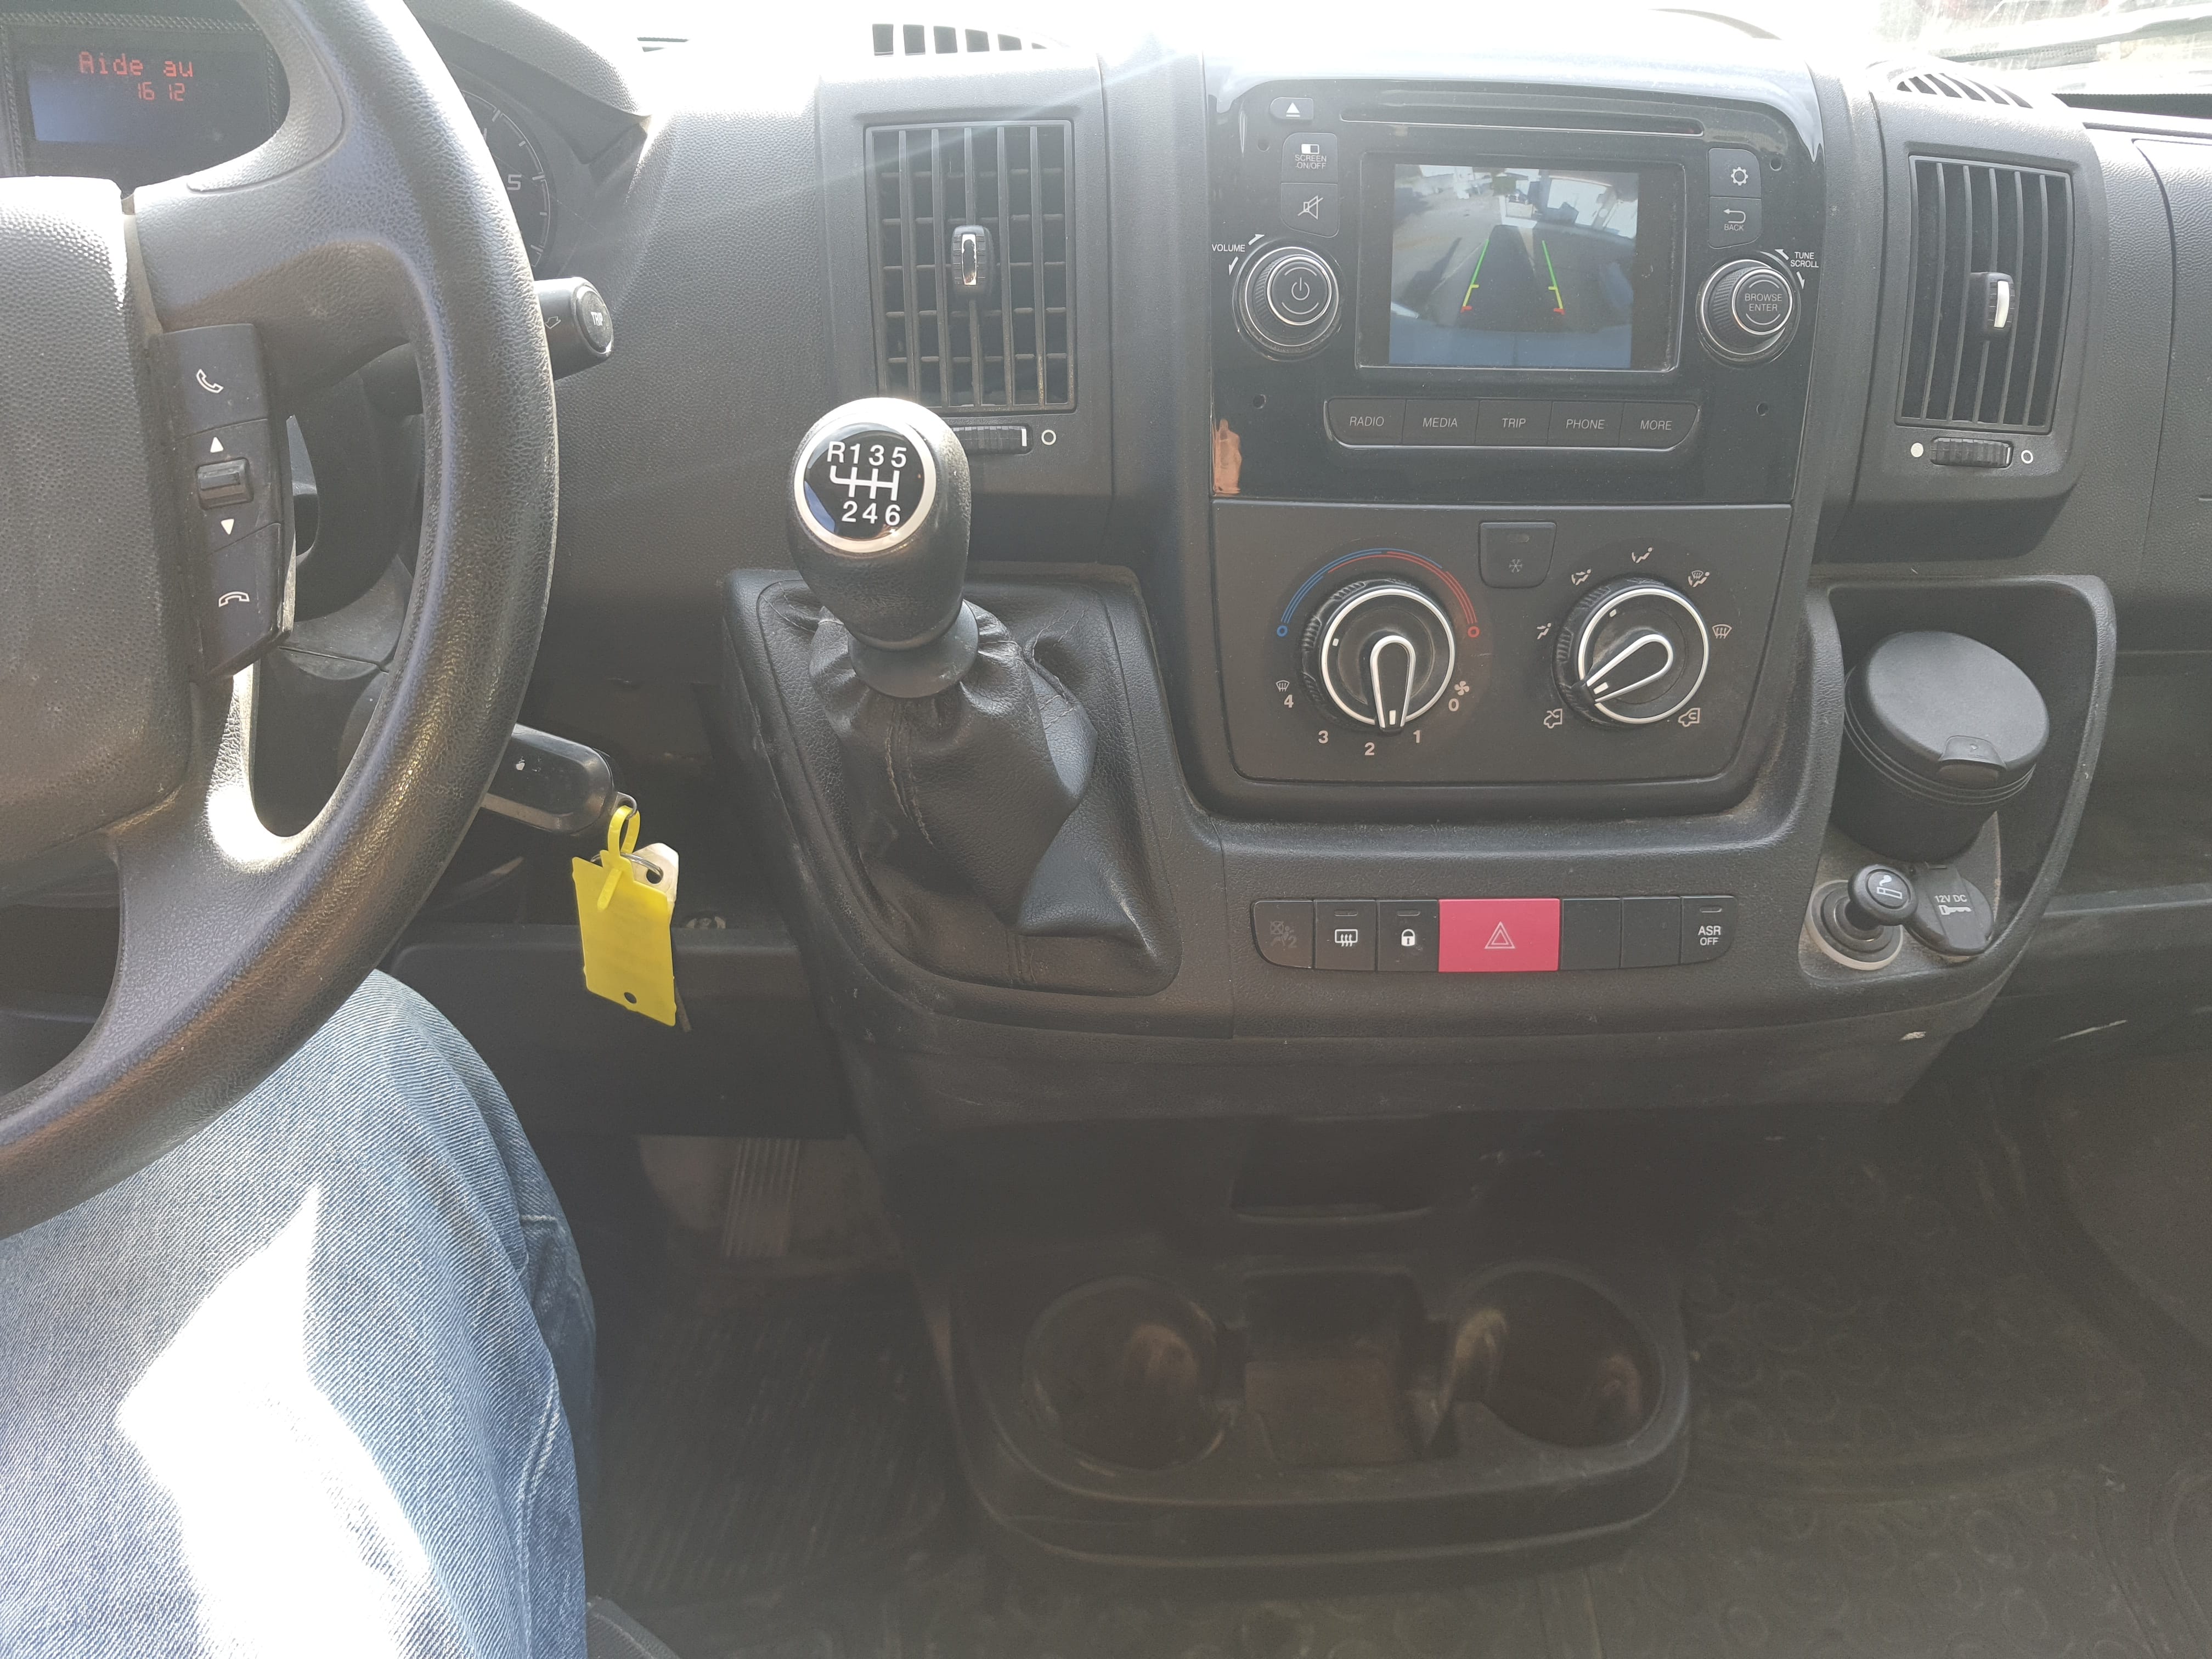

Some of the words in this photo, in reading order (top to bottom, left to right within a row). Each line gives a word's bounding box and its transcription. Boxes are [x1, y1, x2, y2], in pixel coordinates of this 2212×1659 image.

[79, 51, 143, 76] Aide
[163, 60, 193, 77] au
[506, 174, 522, 190] 5
[1211, 244, 1246, 252] VOLUME
[1795, 251, 1815, 259] TUNE
[1790, 259, 1819, 268] SCROLL
[1745, 293, 1782, 302] BROWSE
[1749, 303, 1778, 312] ENTER
[1349, 416, 1385, 427] RADIO
[1422, 417, 1458, 428] MEDIA
[1502, 418, 1527, 428] TRIP
[1565, 419, 1605, 430] PHONE
[1640, 420, 1673, 431] MORE
[1284, 694, 1294, 708] 4
[1448, 698, 1460, 712] 0
[1318, 730, 1329, 744] 3
[1413, 730, 1421, 743] 1
[1364, 742, 1375, 756] 2
[1934, 894, 1951, 903] 12V
[1953, 894, 1967, 902] DC
[1697, 925, 1722, 936] ASR
[1700, 937, 1719, 946] OFF
